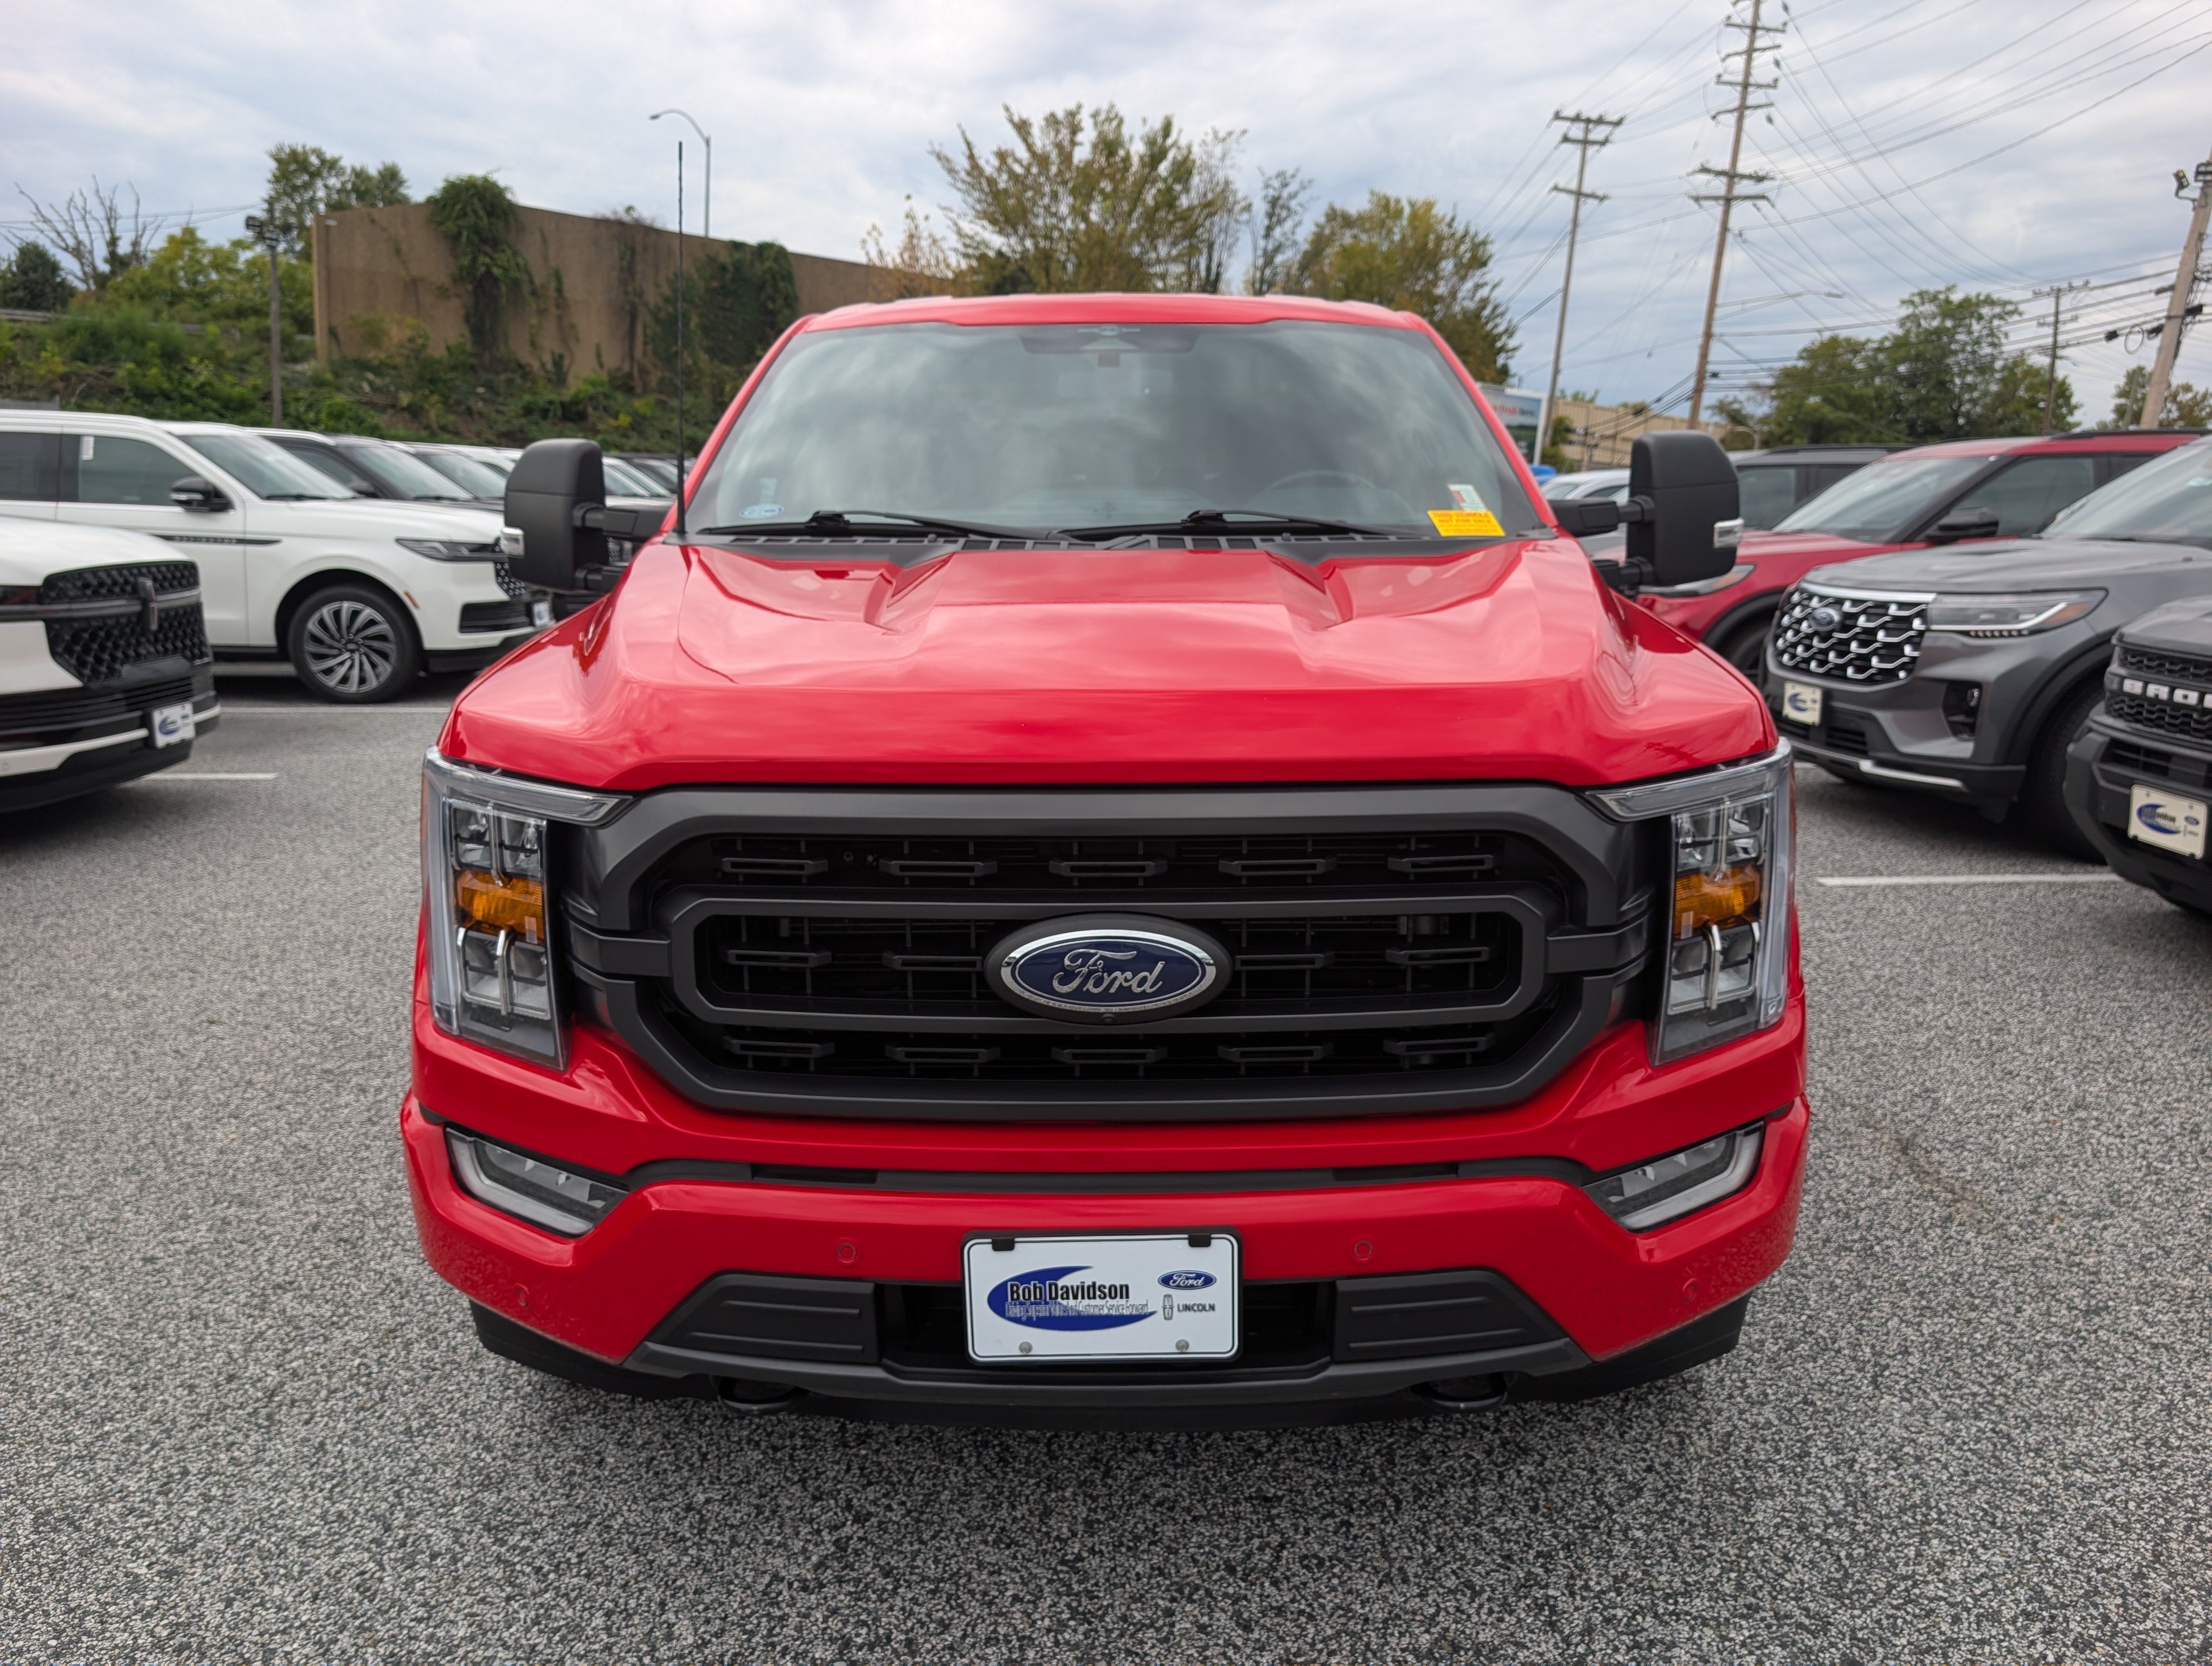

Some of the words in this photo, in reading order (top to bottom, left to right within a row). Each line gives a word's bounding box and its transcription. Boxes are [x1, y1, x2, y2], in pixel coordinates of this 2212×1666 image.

[1052, 949, 1165, 994] Ford
[1169, 1273, 1205, 1286] Ford
[1008, 1281, 1045, 1302] Bob
[1047, 1281, 1131, 1301] Davidson
[1177, 1303, 1216, 1312] LINCOLN
